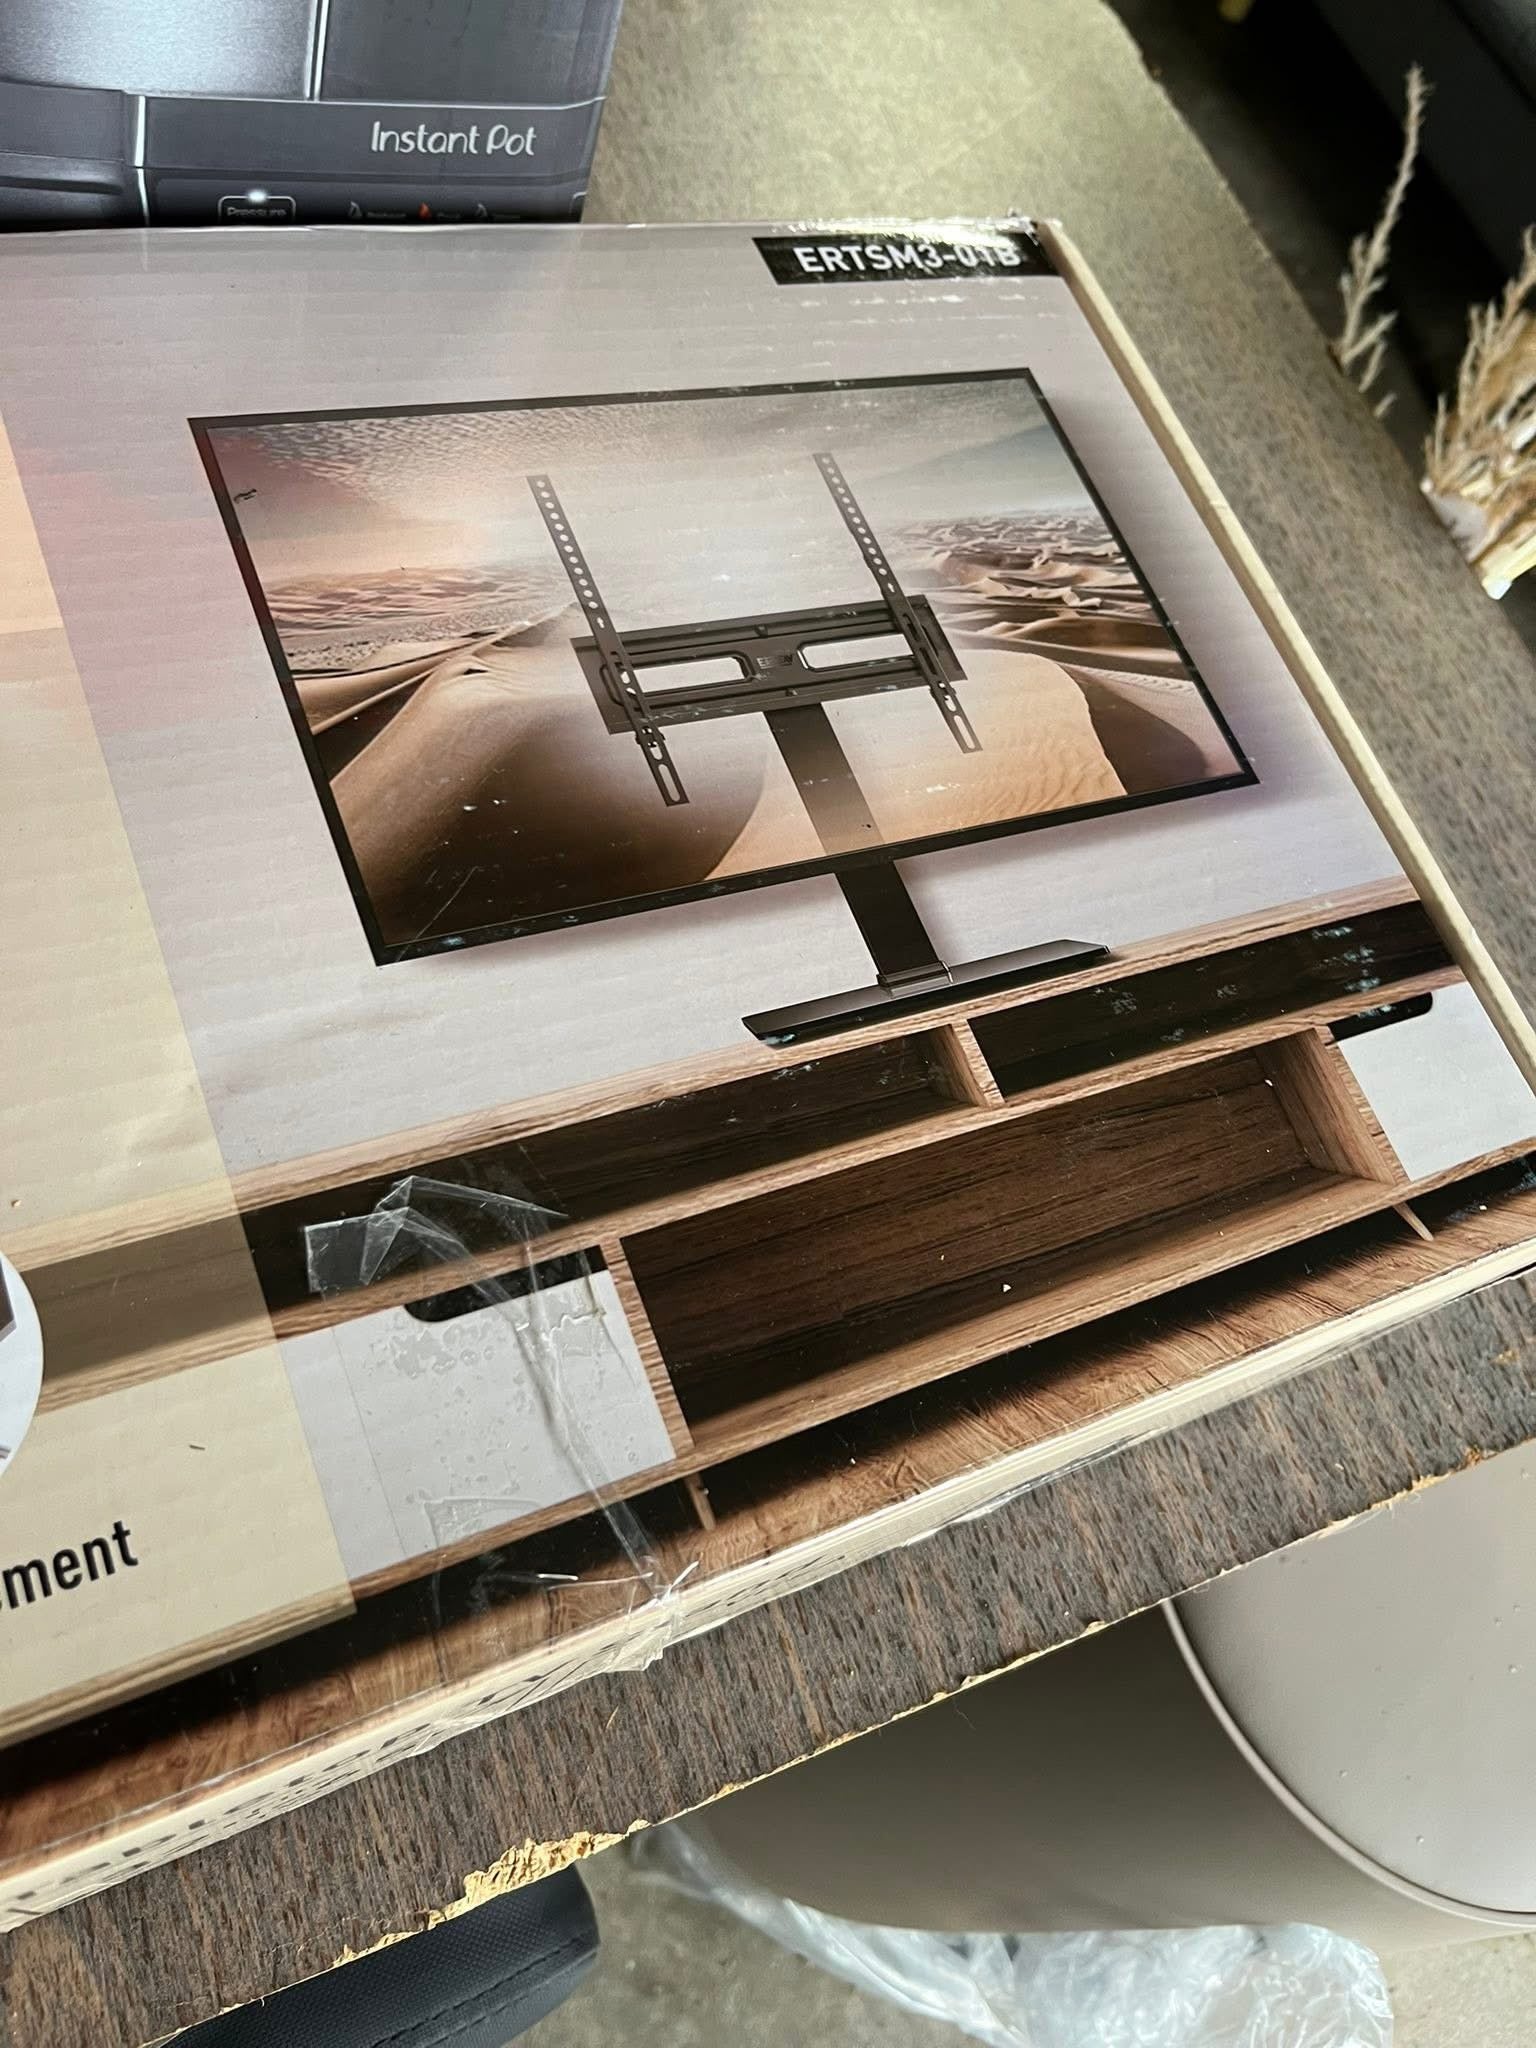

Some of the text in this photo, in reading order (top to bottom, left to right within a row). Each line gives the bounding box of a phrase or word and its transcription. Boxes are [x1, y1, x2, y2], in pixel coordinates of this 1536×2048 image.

[371, 121, 537, 156] Instant Pot
[0, 1520, 139, 1612] ment
